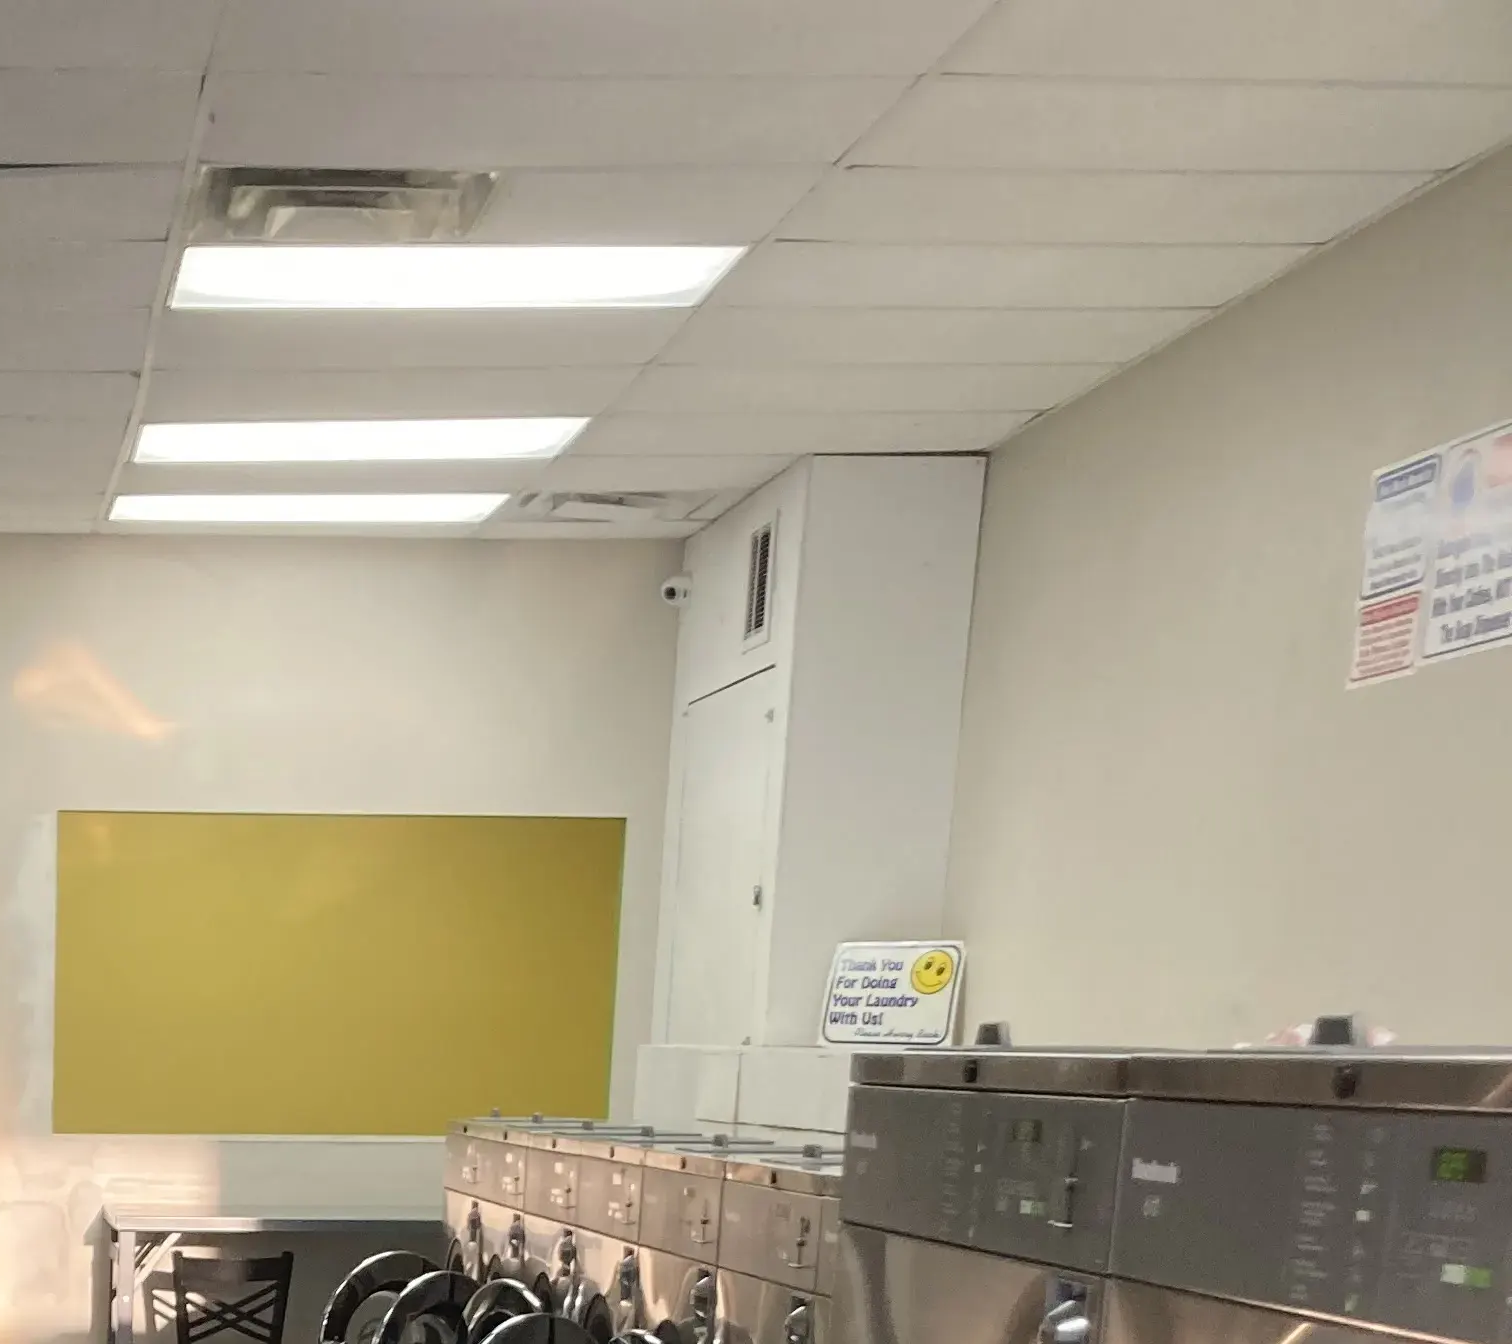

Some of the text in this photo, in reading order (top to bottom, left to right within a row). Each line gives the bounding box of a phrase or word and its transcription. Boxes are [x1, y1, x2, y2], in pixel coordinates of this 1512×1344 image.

[841, 958, 904, 971] Thank You
[836, 976, 899, 989] For Doing
[832, 993, 919, 1007] Your Laundry
[829, 1011, 884, 1026] With Us!
